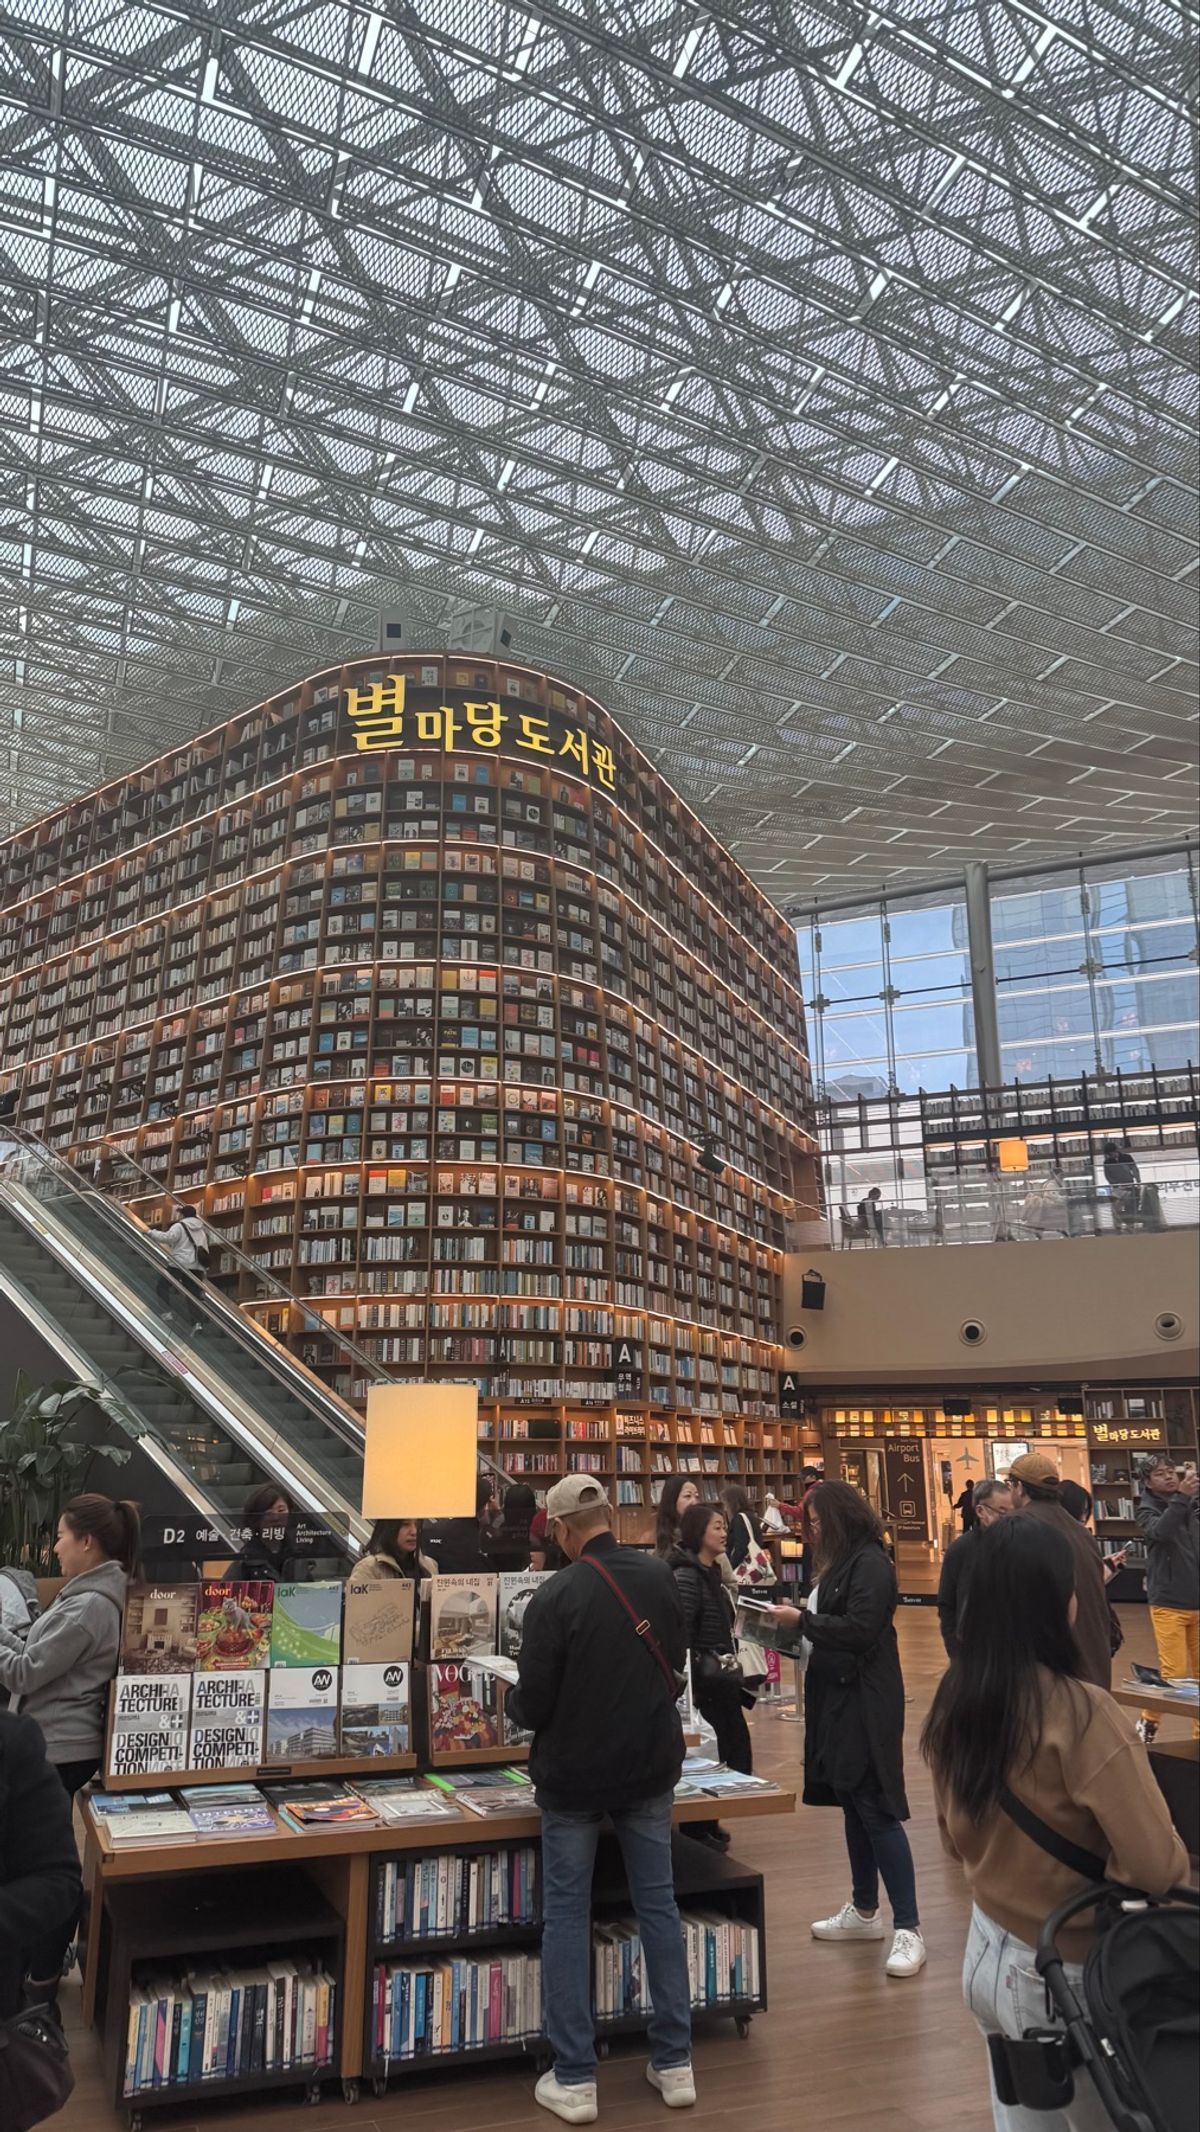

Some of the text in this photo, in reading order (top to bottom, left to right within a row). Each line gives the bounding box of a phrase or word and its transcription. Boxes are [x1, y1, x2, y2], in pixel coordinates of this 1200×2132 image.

[618, 1343, 632, 1363] A
[783, 1375, 796, 1391] A
[887, 1443, 920, 1454] Airport
[903, 1453, 921, 1463] Bus
[163, 1528, 185, 1544] D2
[195, 1527, 286, 1542] 예술 건축 리빙
[296, 1529, 332, 1537] Architecture
[296, 1536, 314, 1544] Living
[149, 1588, 177, 1600] door
[205, 1585, 231, 1597] door
[118, 1696, 178, 1713] TECTURE
[195, 1692, 255, 1709] TECTURE
[117, 1732, 170, 1749] DESIGN
[194, 1727, 246, 1744] DESIGN
